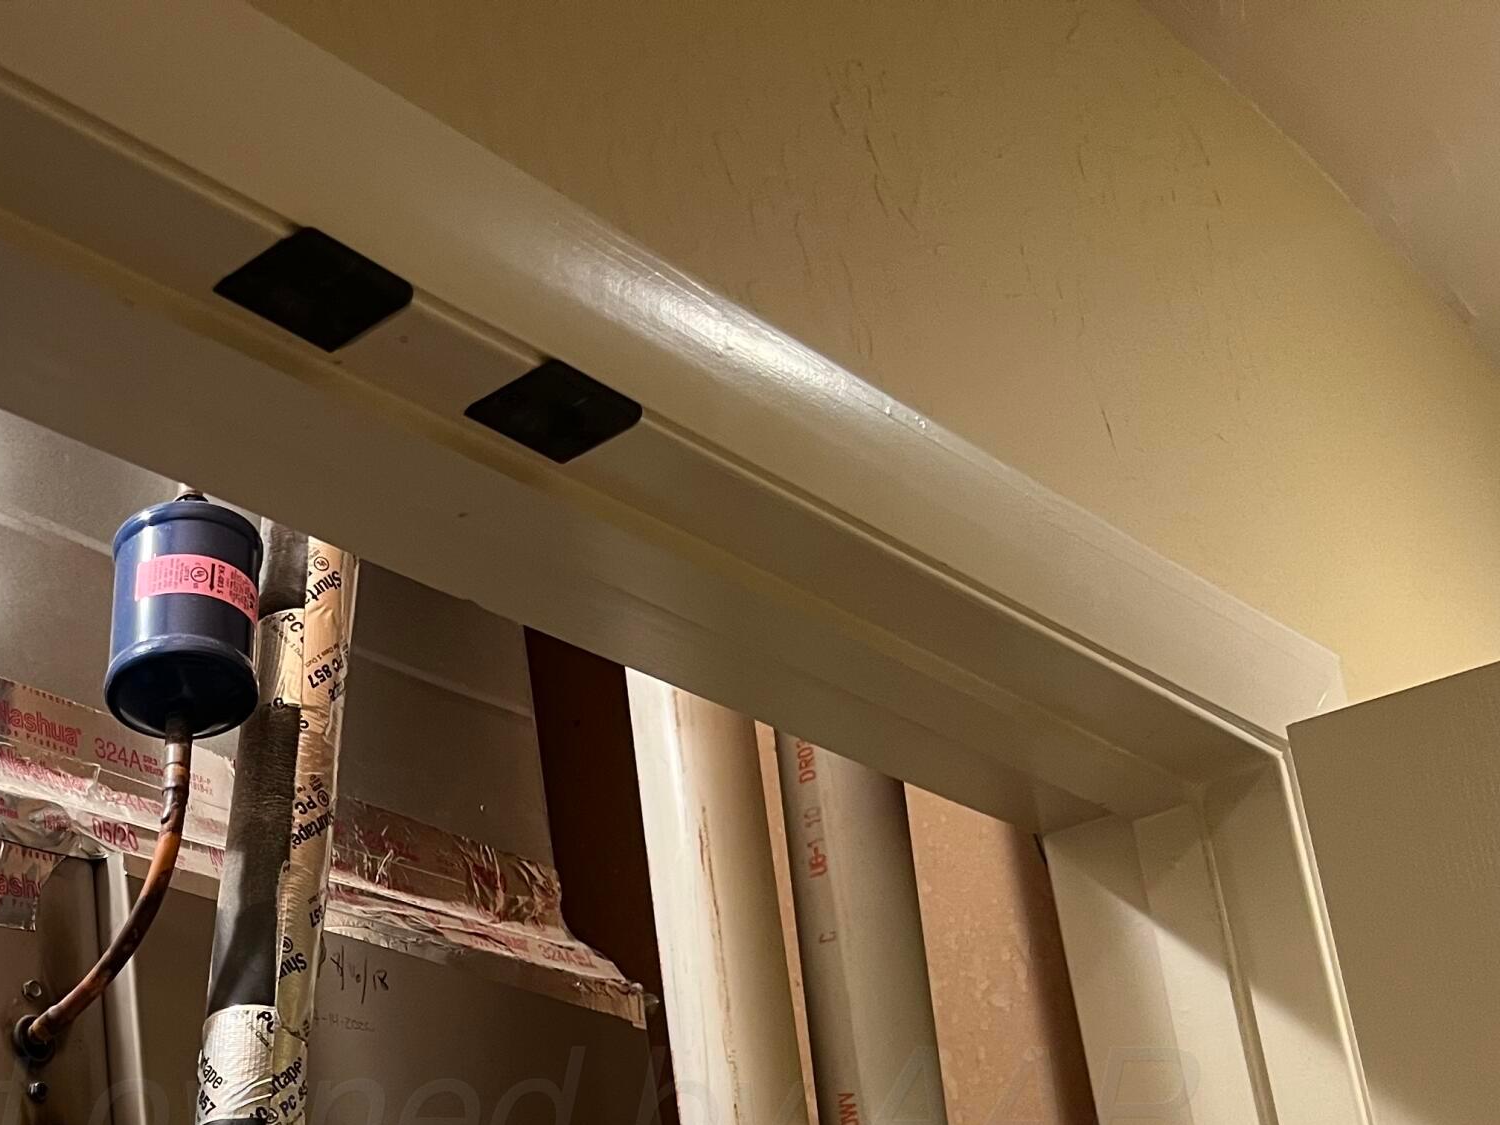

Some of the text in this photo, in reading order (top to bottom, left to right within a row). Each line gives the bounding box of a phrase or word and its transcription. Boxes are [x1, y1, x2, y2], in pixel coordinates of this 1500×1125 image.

[308, 663, 333, 689] 857
[94, 737, 143, 773] 324A
[271, 1057, 303, 1098] rtape
[279, 1094, 297, 1118] PC
